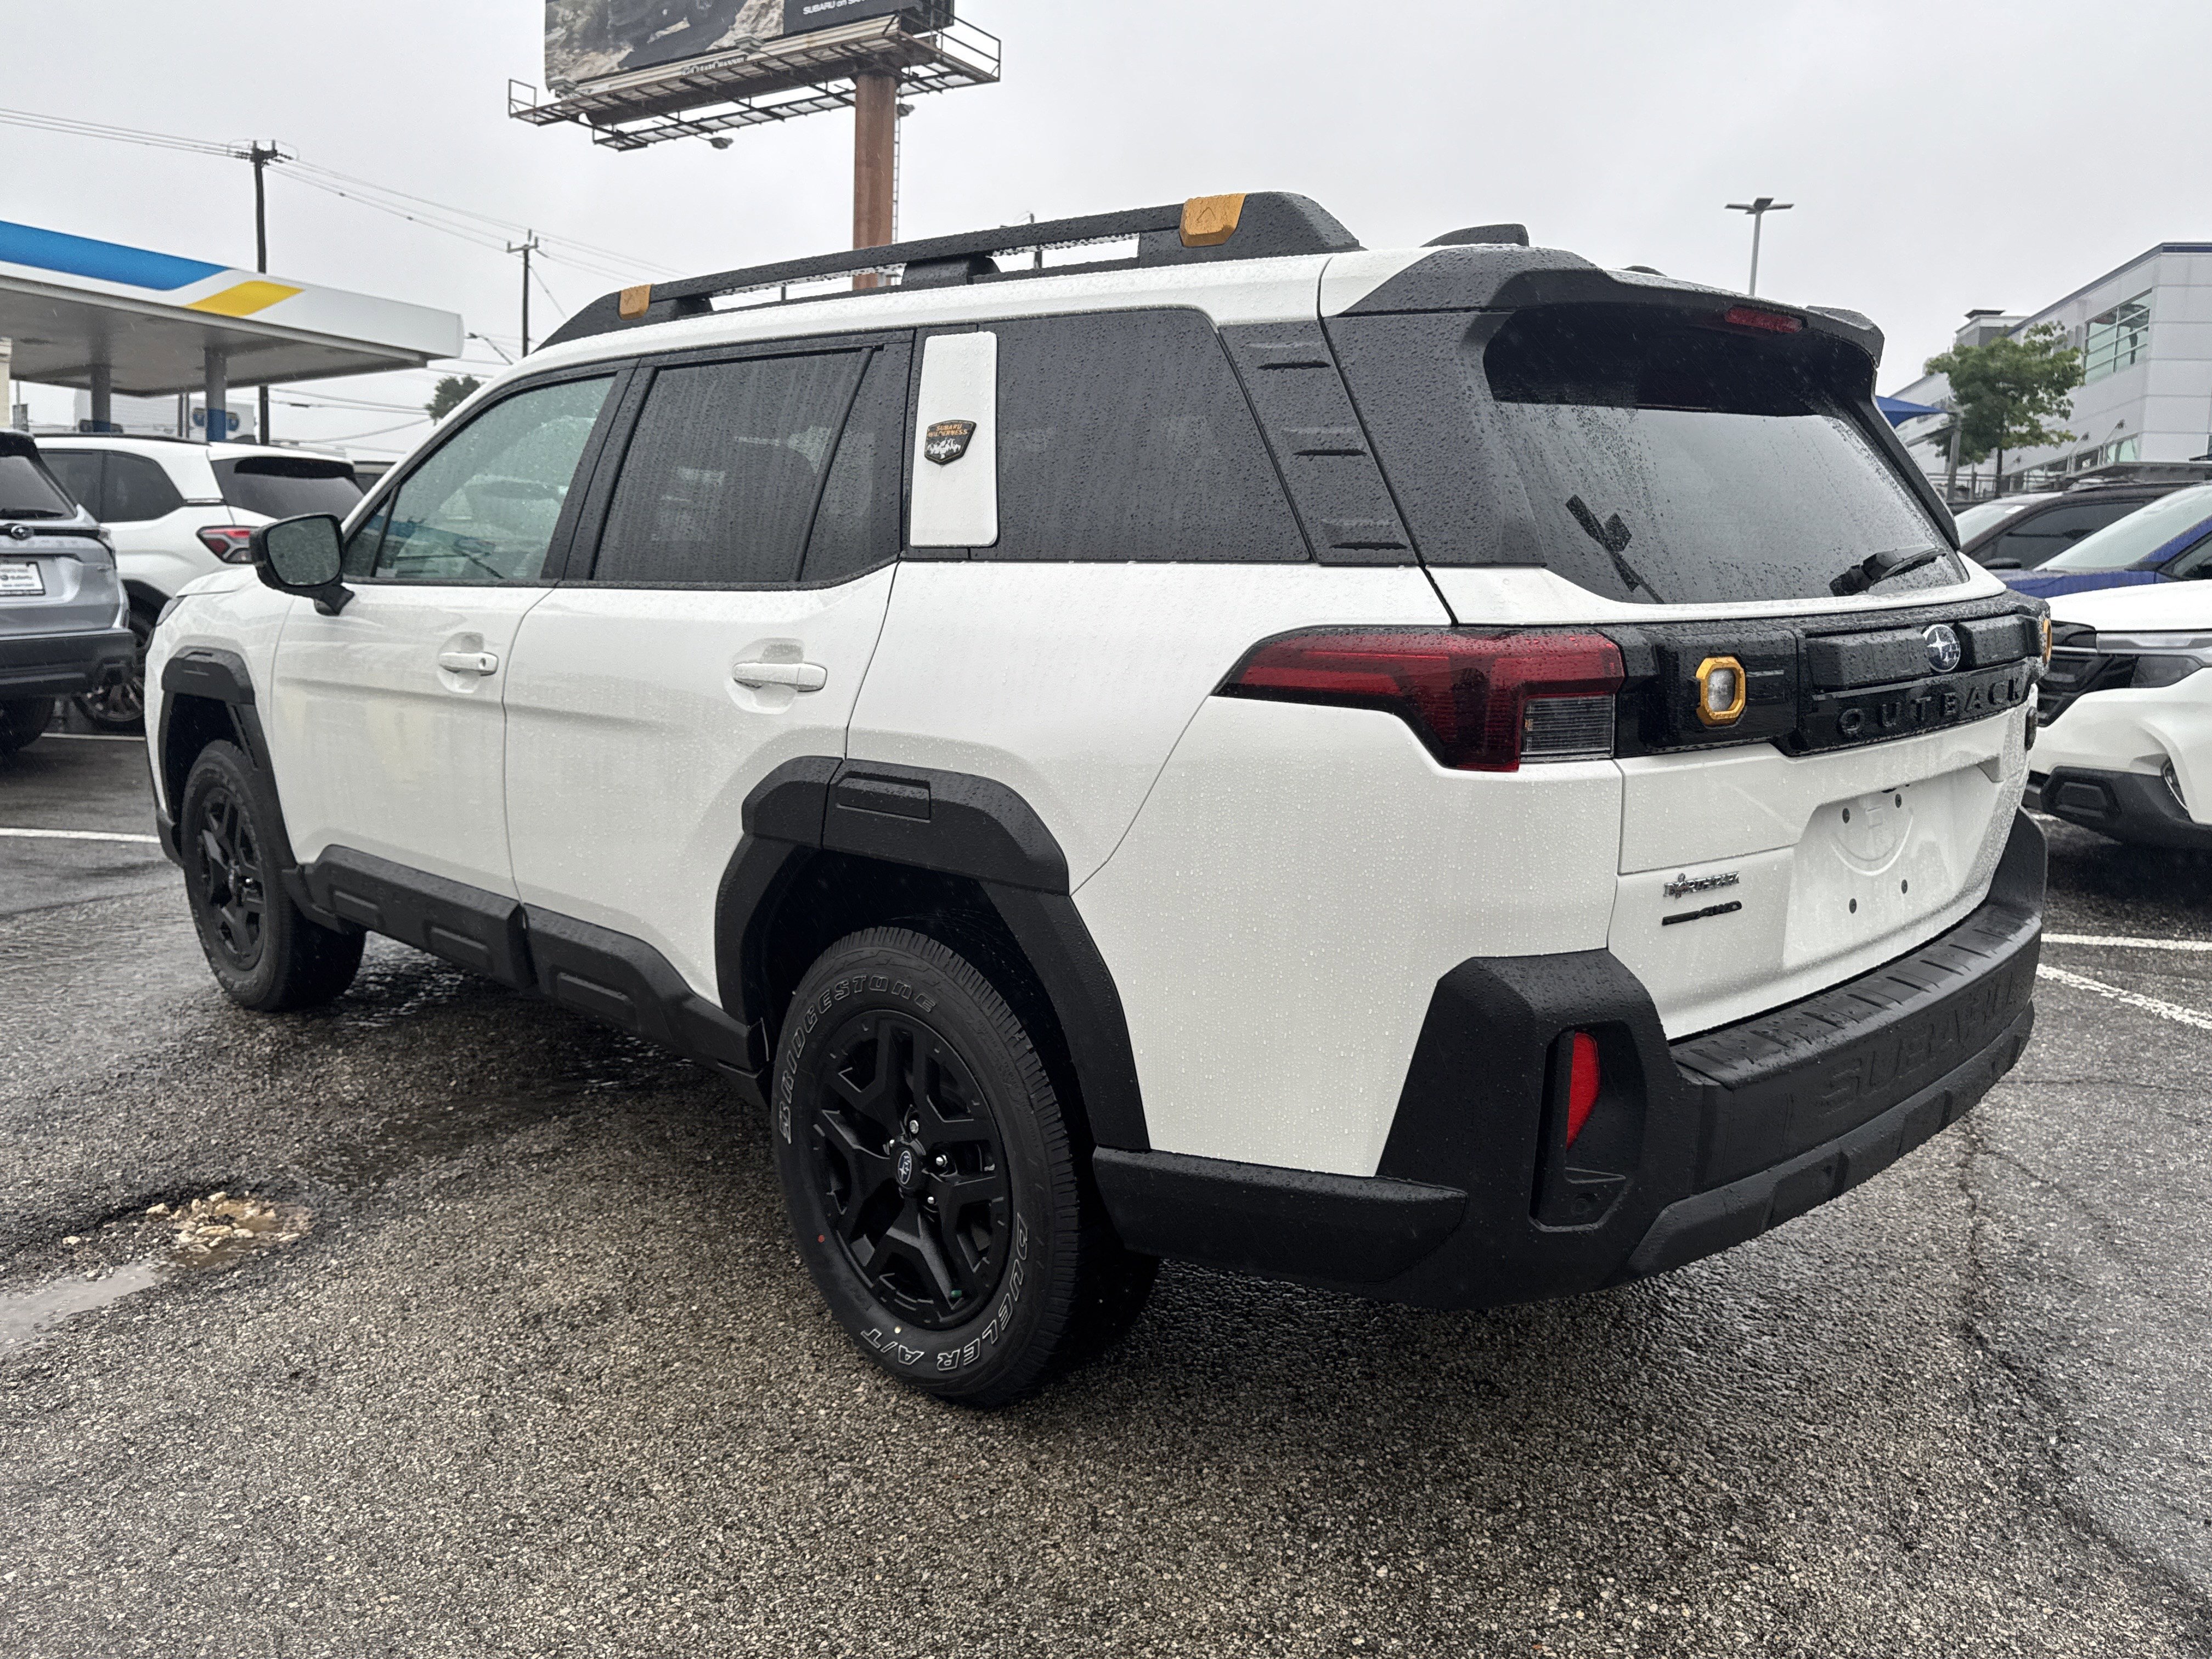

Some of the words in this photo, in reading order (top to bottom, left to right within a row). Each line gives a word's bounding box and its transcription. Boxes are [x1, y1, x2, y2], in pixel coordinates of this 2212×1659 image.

[803, 1, 836, 15] SUBARU
[928, 429, 968, 437] WILDERNESS
[1837, 678, 2022, 738] OUTBACK
[779, 975, 937, 1144] BRIDGESTONE
[936, 1212, 1029, 1371] DUELER
[860, 1328, 925, 1365] A/T
